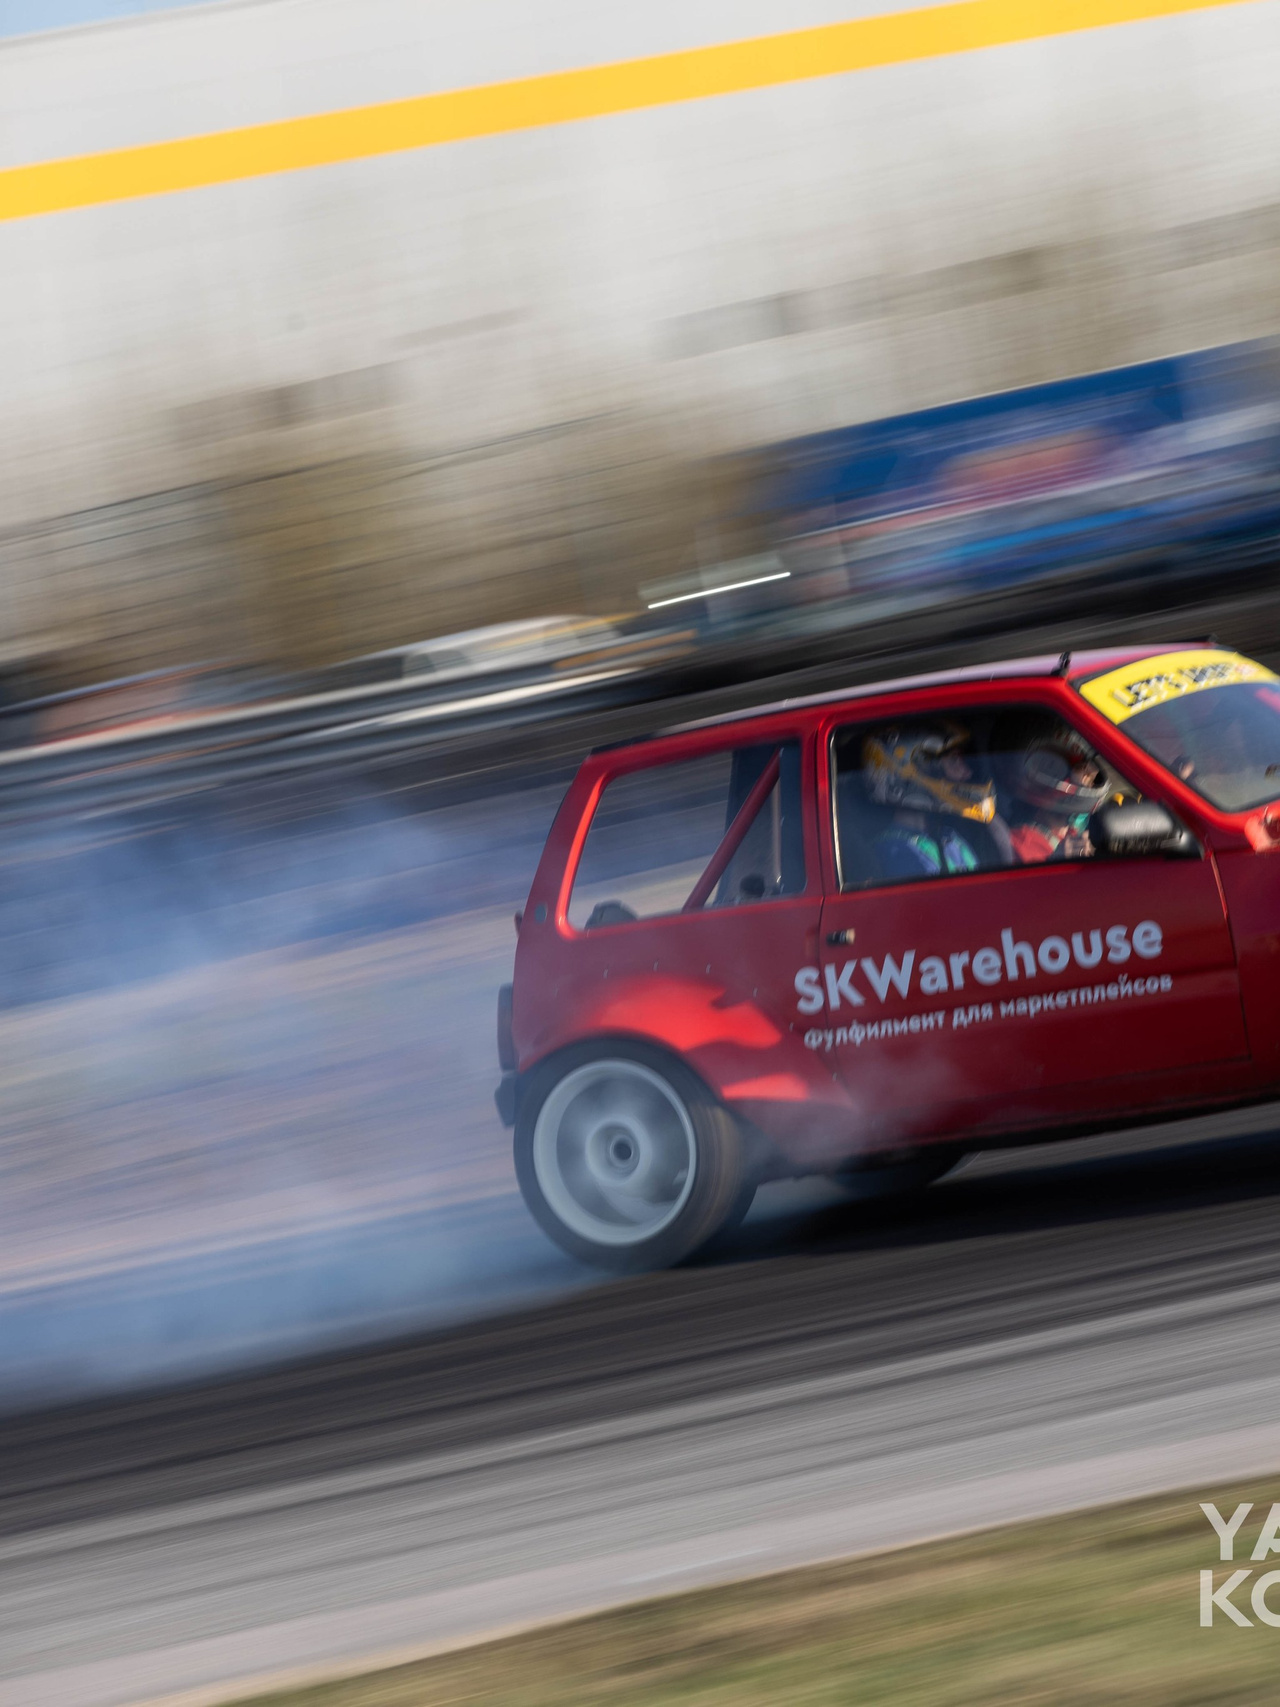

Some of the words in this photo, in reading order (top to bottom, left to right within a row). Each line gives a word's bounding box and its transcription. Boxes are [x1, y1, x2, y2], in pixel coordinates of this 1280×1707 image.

[794, 919, 1163, 1015] SKWarehouse
[952, 1002, 994, 1030] для
[1000, 973, 1173, 1018] маркетплейсов
